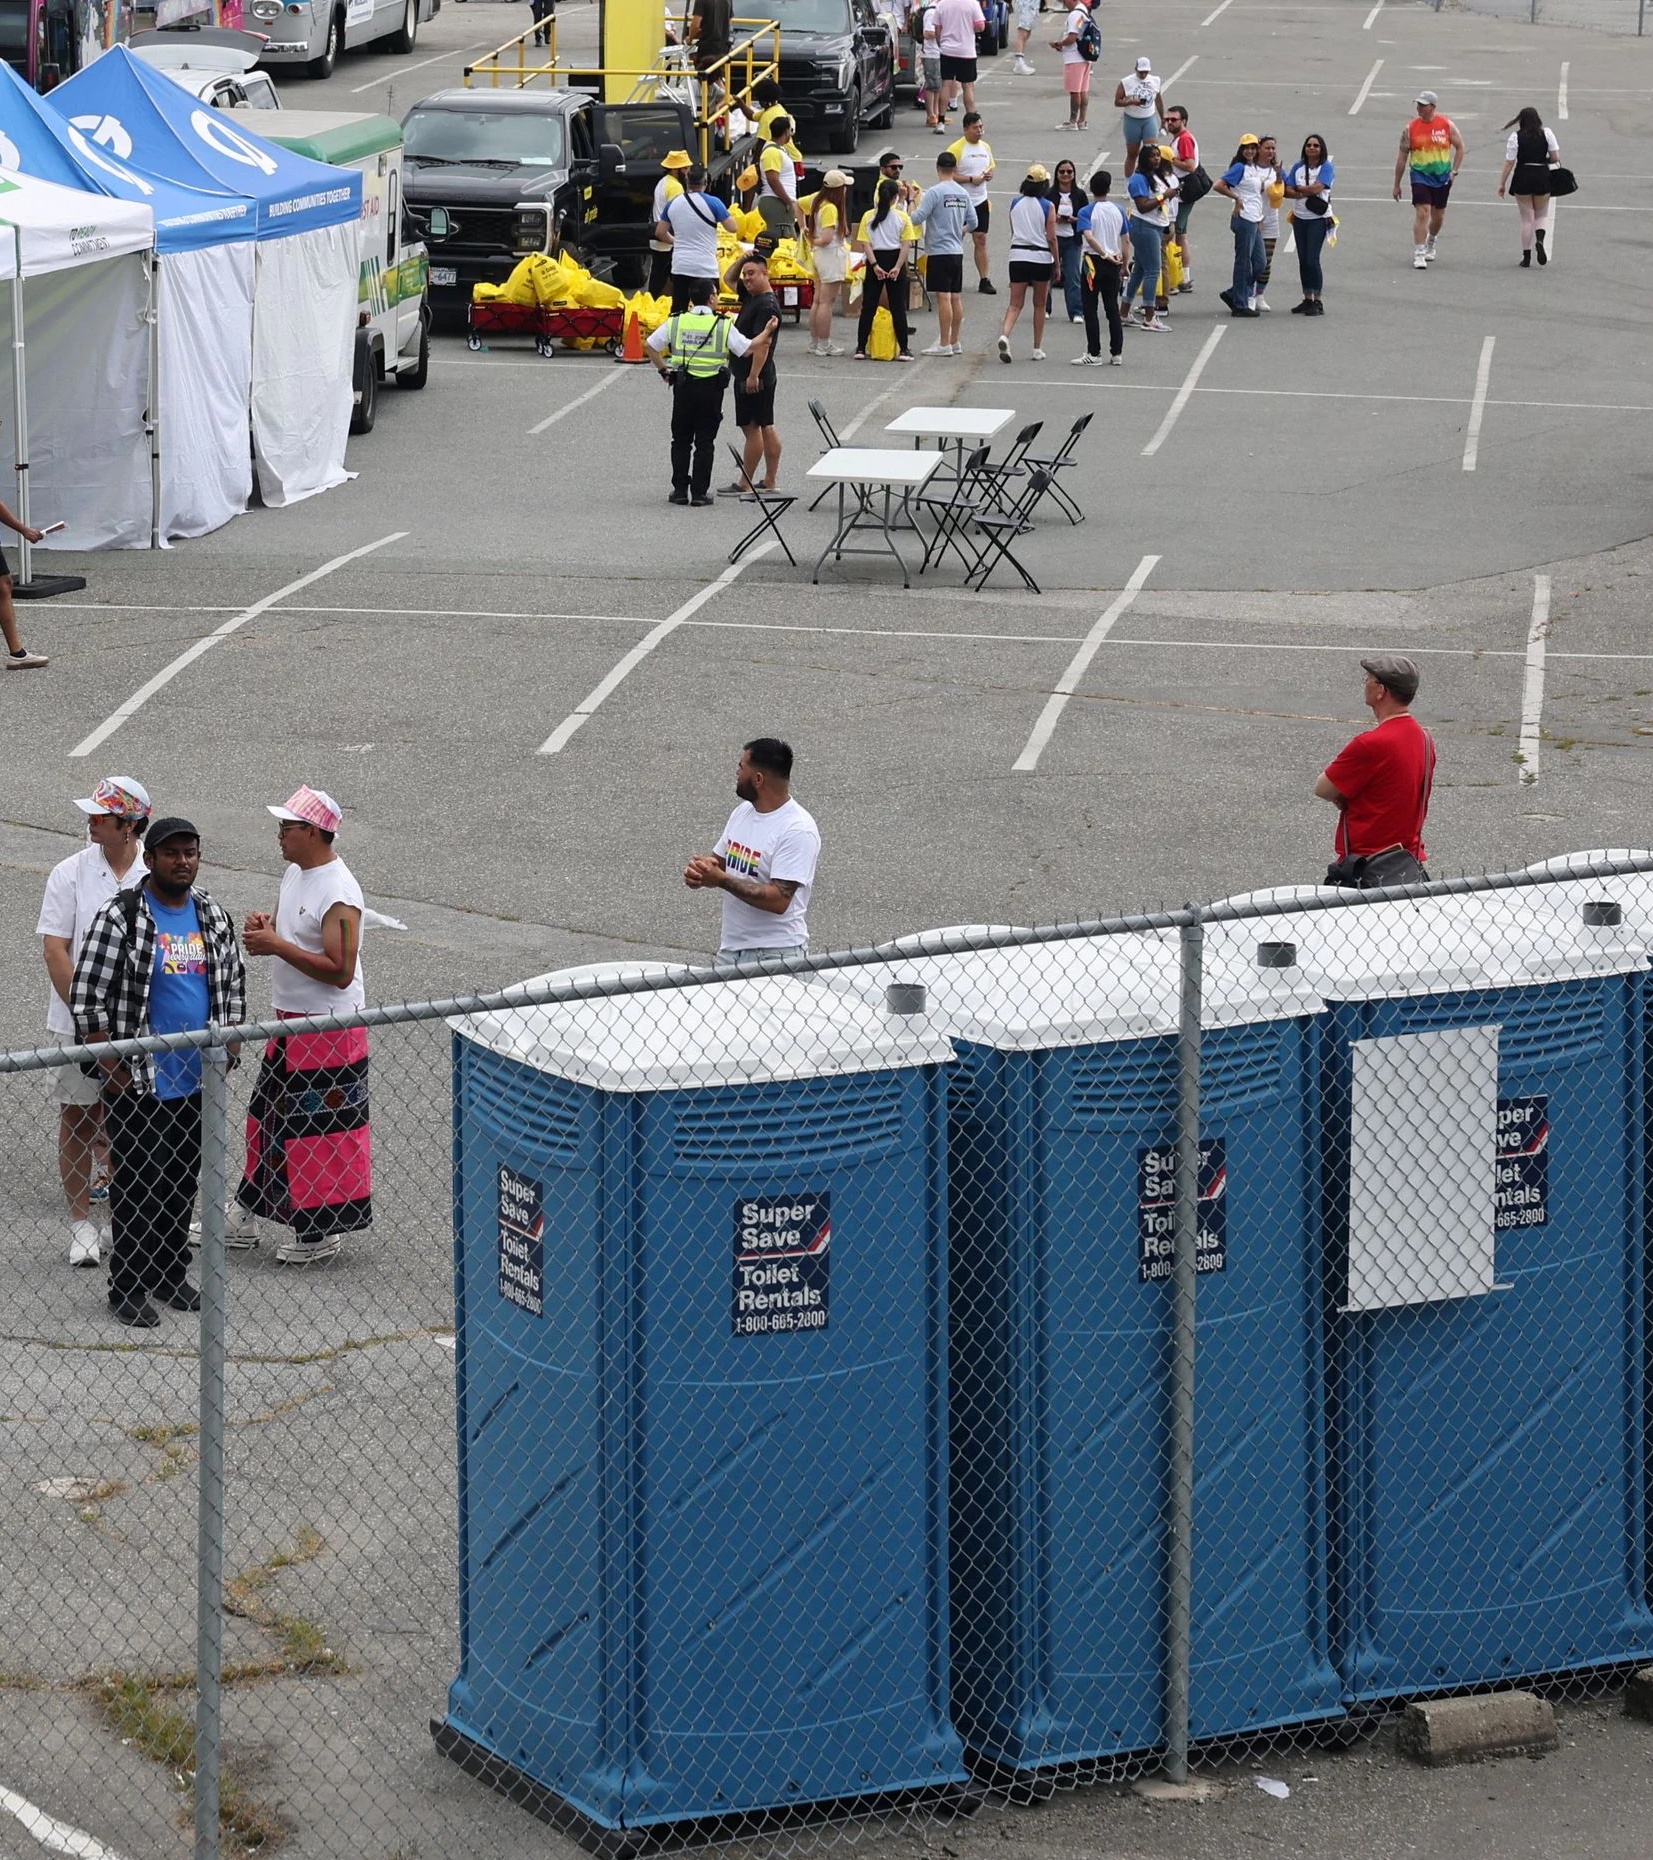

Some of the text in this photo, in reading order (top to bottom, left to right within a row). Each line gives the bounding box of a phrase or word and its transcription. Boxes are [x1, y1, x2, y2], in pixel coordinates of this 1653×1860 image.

[269, 187, 351, 218] BUILDING COMMUNITIES TOGETHER
[77, 225, 97, 239] READY
[71, 237, 111, 257] COMMITMENT
[170, 943, 203, 955] PRIDE
[1498, 1107, 1534, 1130] per
[1496, 1131, 1522, 1149] ve
[1496, 1163, 1521, 1184] let
[500, 1169, 536, 1205] Super
[1493, 1184, 1541, 1208] ntals
[501, 1195, 530, 1226] Save
[741, 1202, 816, 1228] Super
[501, 1229, 530, 1262] Toilet
[741, 1227, 801, 1249] Save
[500, 1253, 540, 1293] Rentals
[739, 1263, 800, 1286] Toilet
[738, 1285, 822, 1311] Rentals
[736, 1310, 826, 1333] 1-800-665-2800
